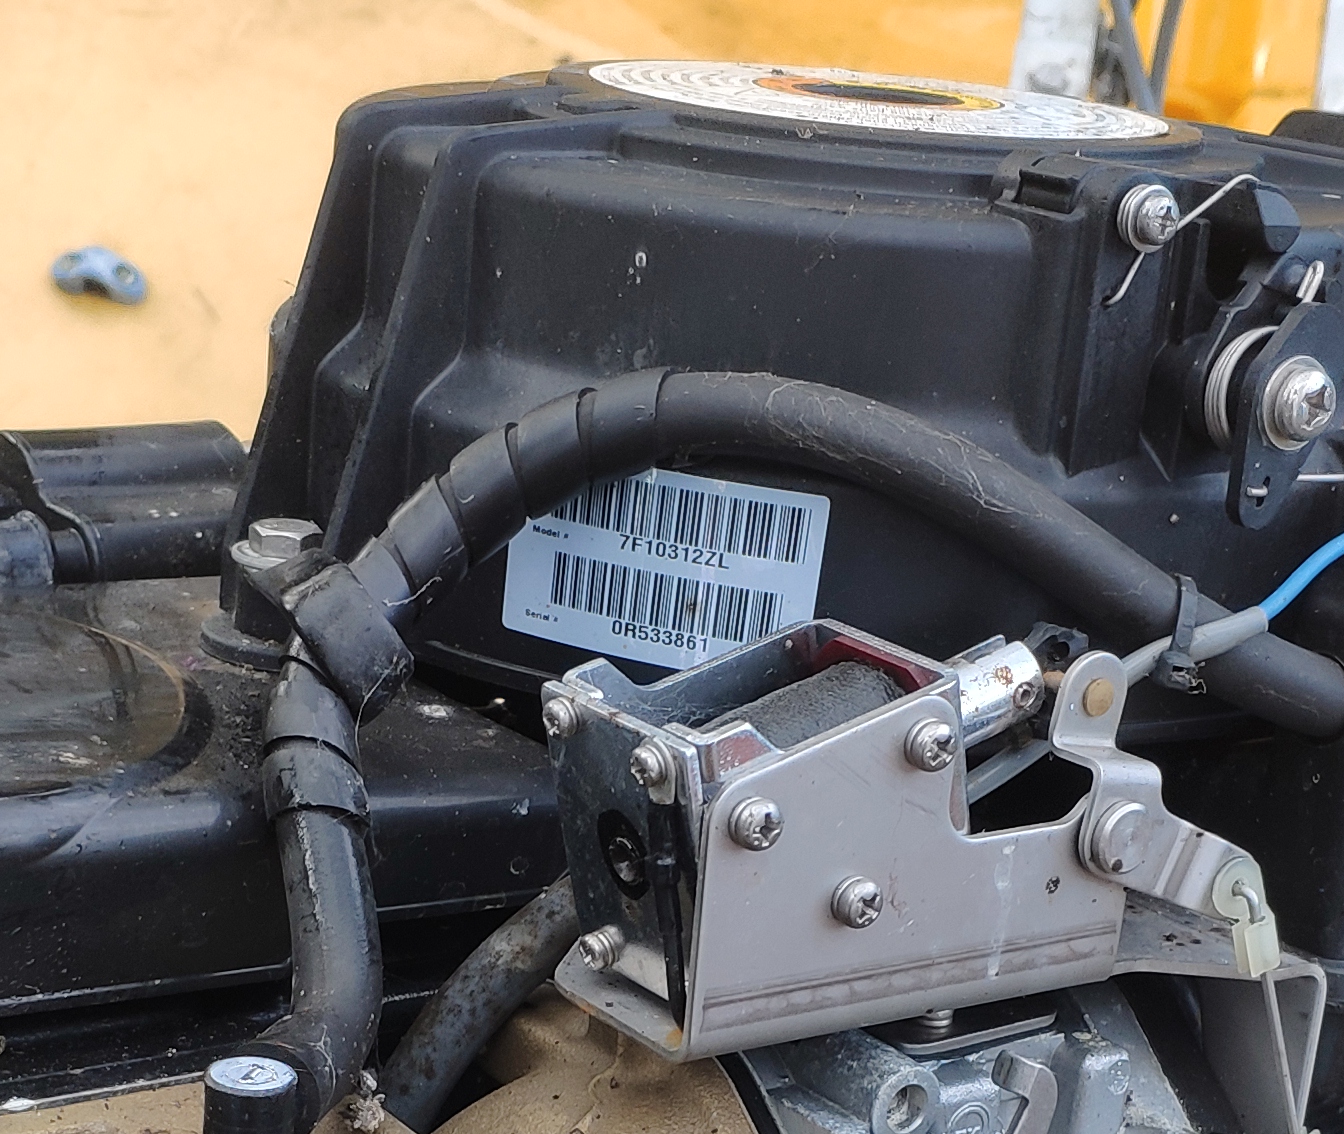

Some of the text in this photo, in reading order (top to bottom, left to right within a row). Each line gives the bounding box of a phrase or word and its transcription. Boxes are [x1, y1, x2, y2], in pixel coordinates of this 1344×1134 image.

[532, 524, 561, 539] Model
[618, 534, 730, 570] 7F10312ZL
[525, 608, 550, 622] Serial
